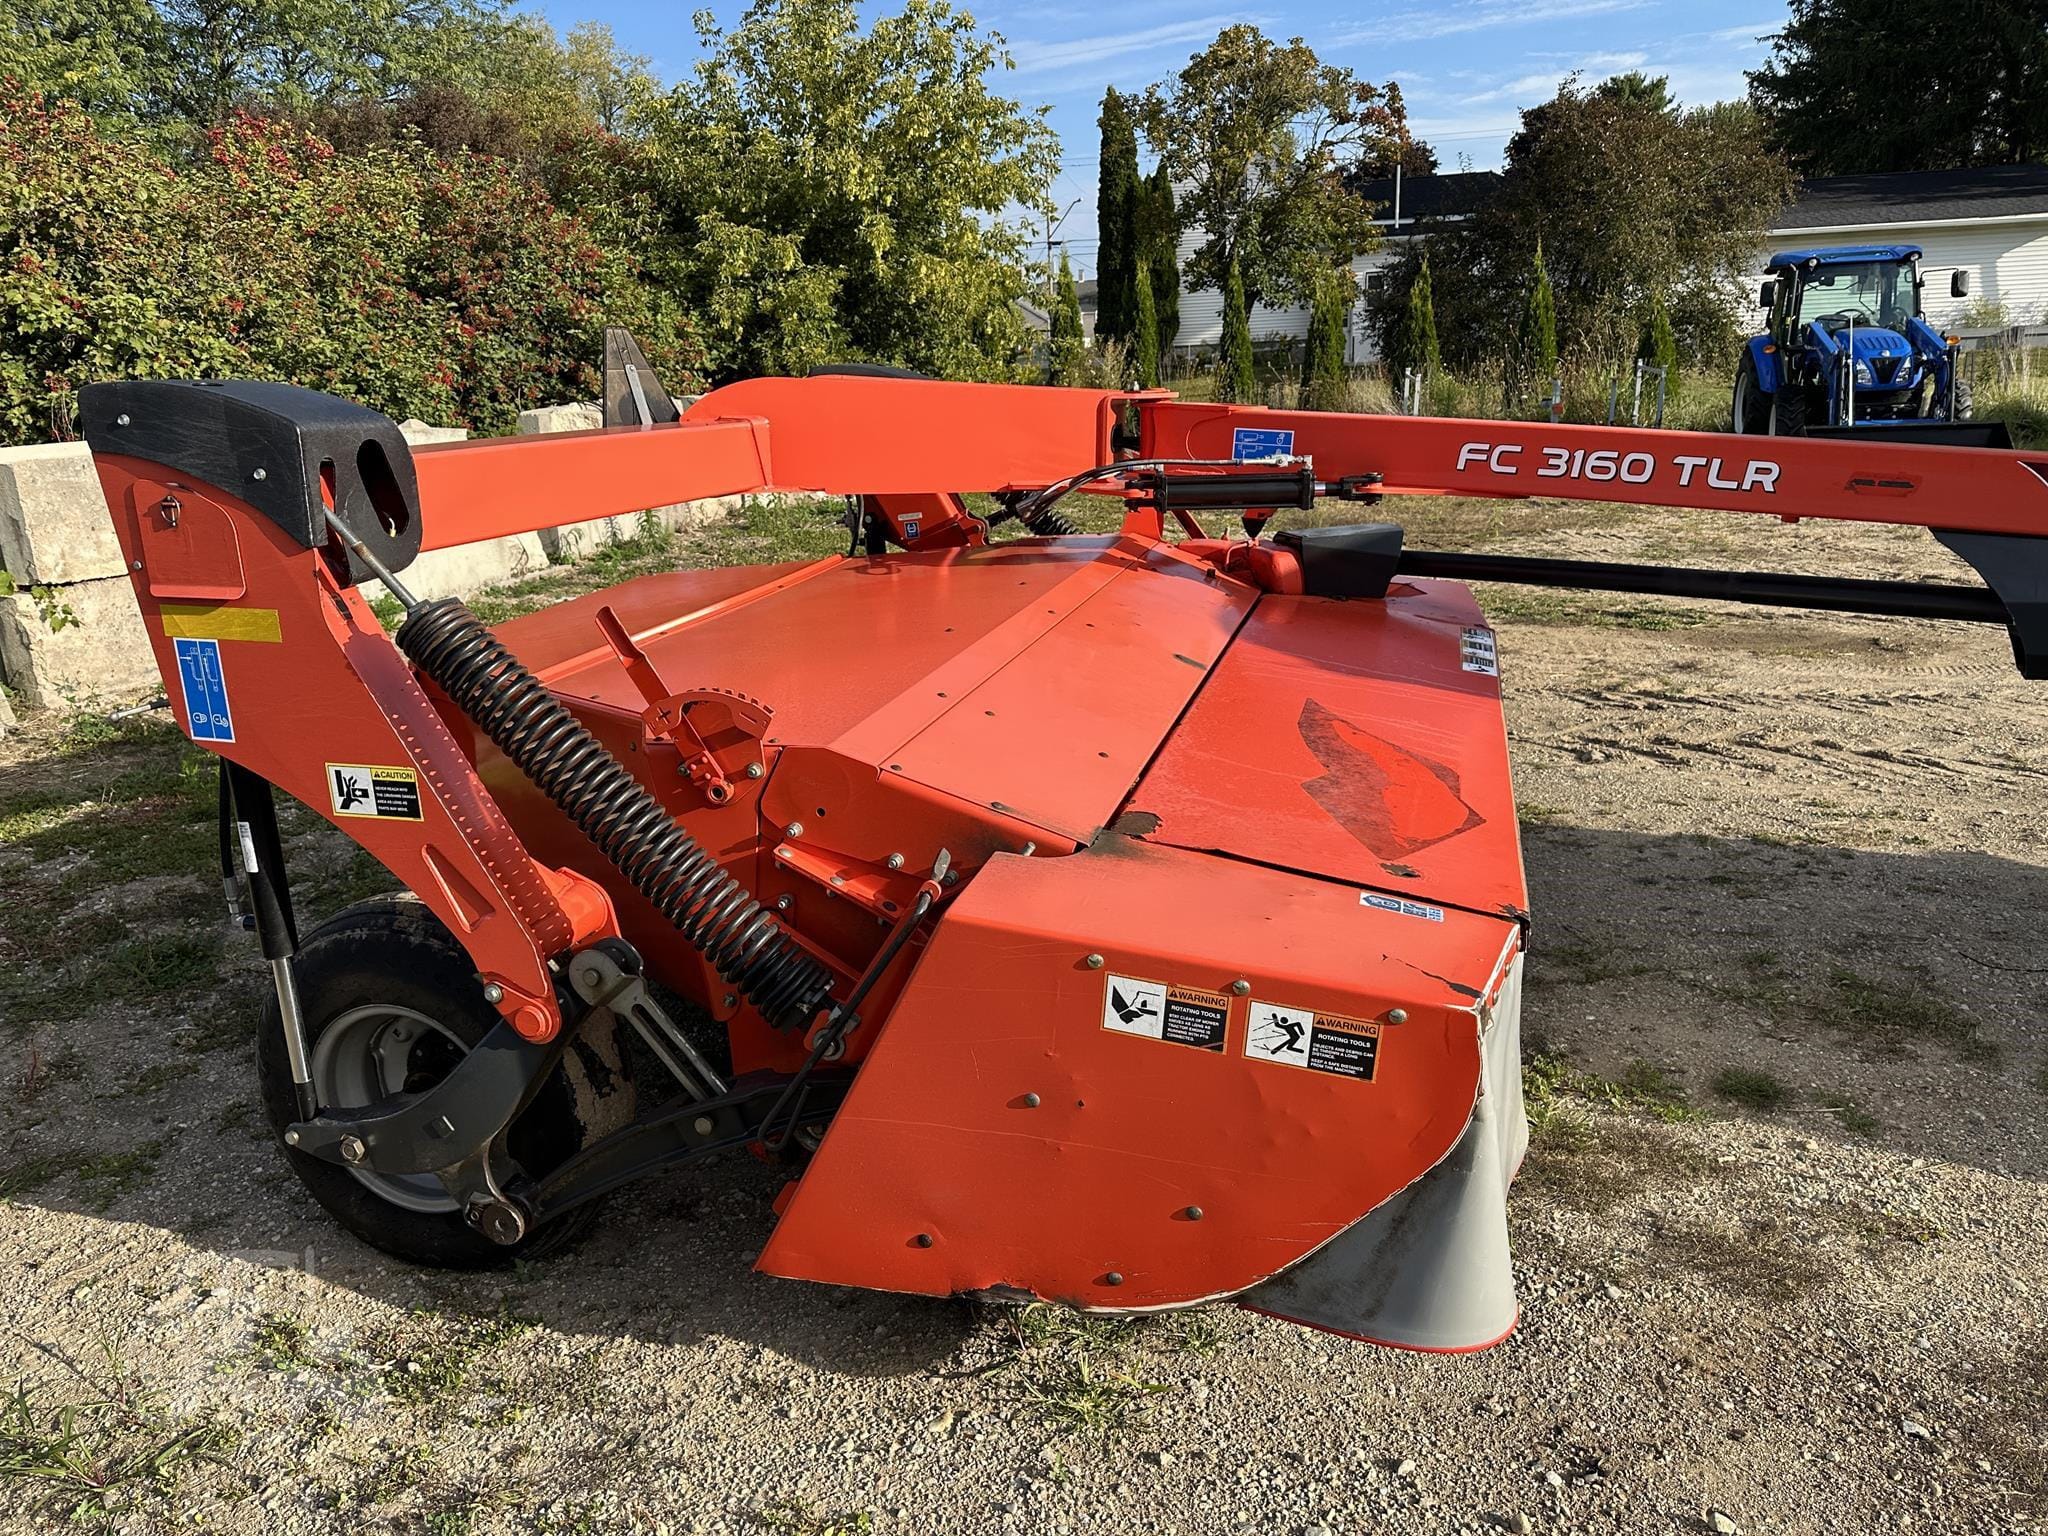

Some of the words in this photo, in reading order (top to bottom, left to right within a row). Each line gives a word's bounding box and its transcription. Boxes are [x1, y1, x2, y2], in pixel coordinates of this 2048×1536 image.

[1456, 443, 1522, 474] FC
[1537, 447, 1656, 483] 3160
[1673, 456, 1781, 492] TLR
[380, 771, 412, 780] CAUTION
[1178, 992, 1226, 1006] WARNING
[1171, 1005, 1200, 1015] ROTATING
[1201, 1010, 1221, 1019] TOOLS
[1326, 1019, 1376, 1034] WARNING
[1313, 1043, 1334, 1051] OBJECTS
[1318, 1034, 1349, 1043] ROTATING
[1350, 1039, 1371, 1048] TOOLS
[1341, 1063, 1363, 1072] DISTANCE
